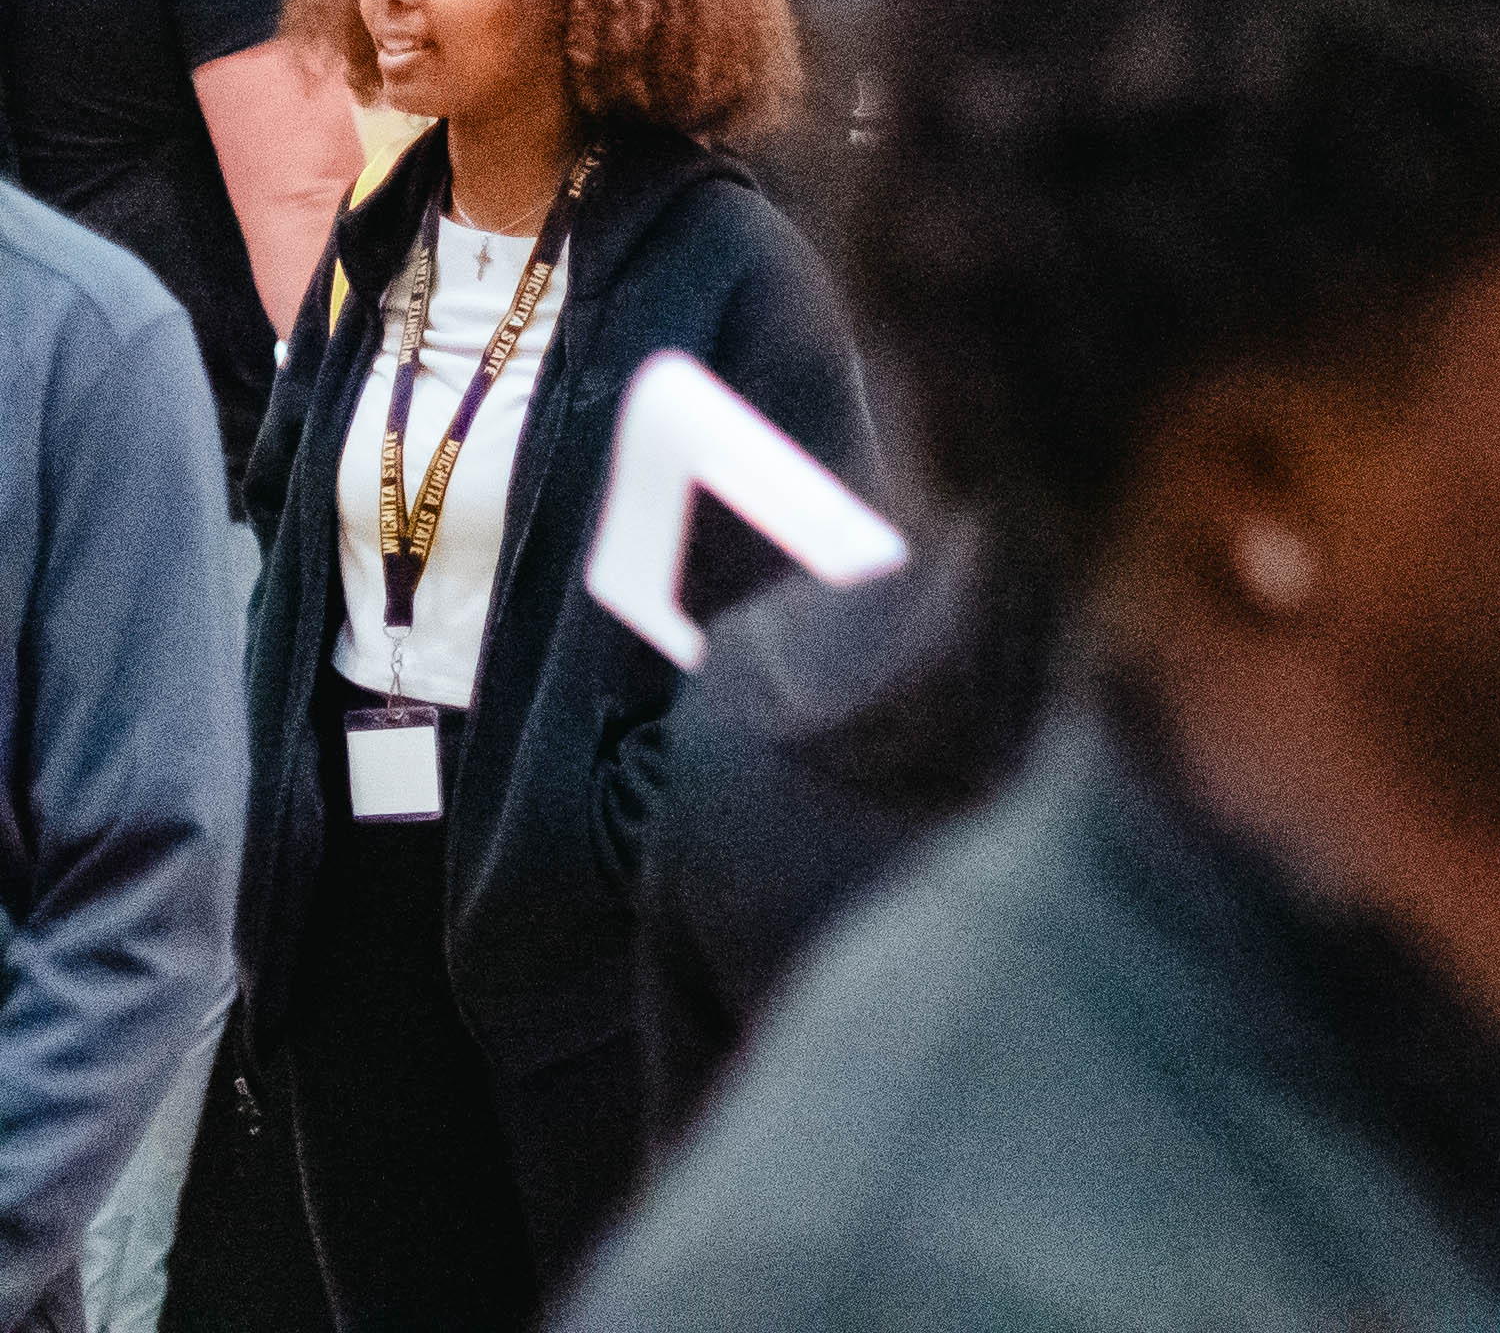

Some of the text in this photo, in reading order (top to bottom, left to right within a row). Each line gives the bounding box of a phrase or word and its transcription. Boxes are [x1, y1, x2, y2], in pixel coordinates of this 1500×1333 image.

[400, 305, 424, 364] WICHITA
[483, 262, 552, 377] WICHITA STATE
[381, 431, 399, 553] WICHITA STATE
[410, 439, 460, 556] WICHITA STATE
